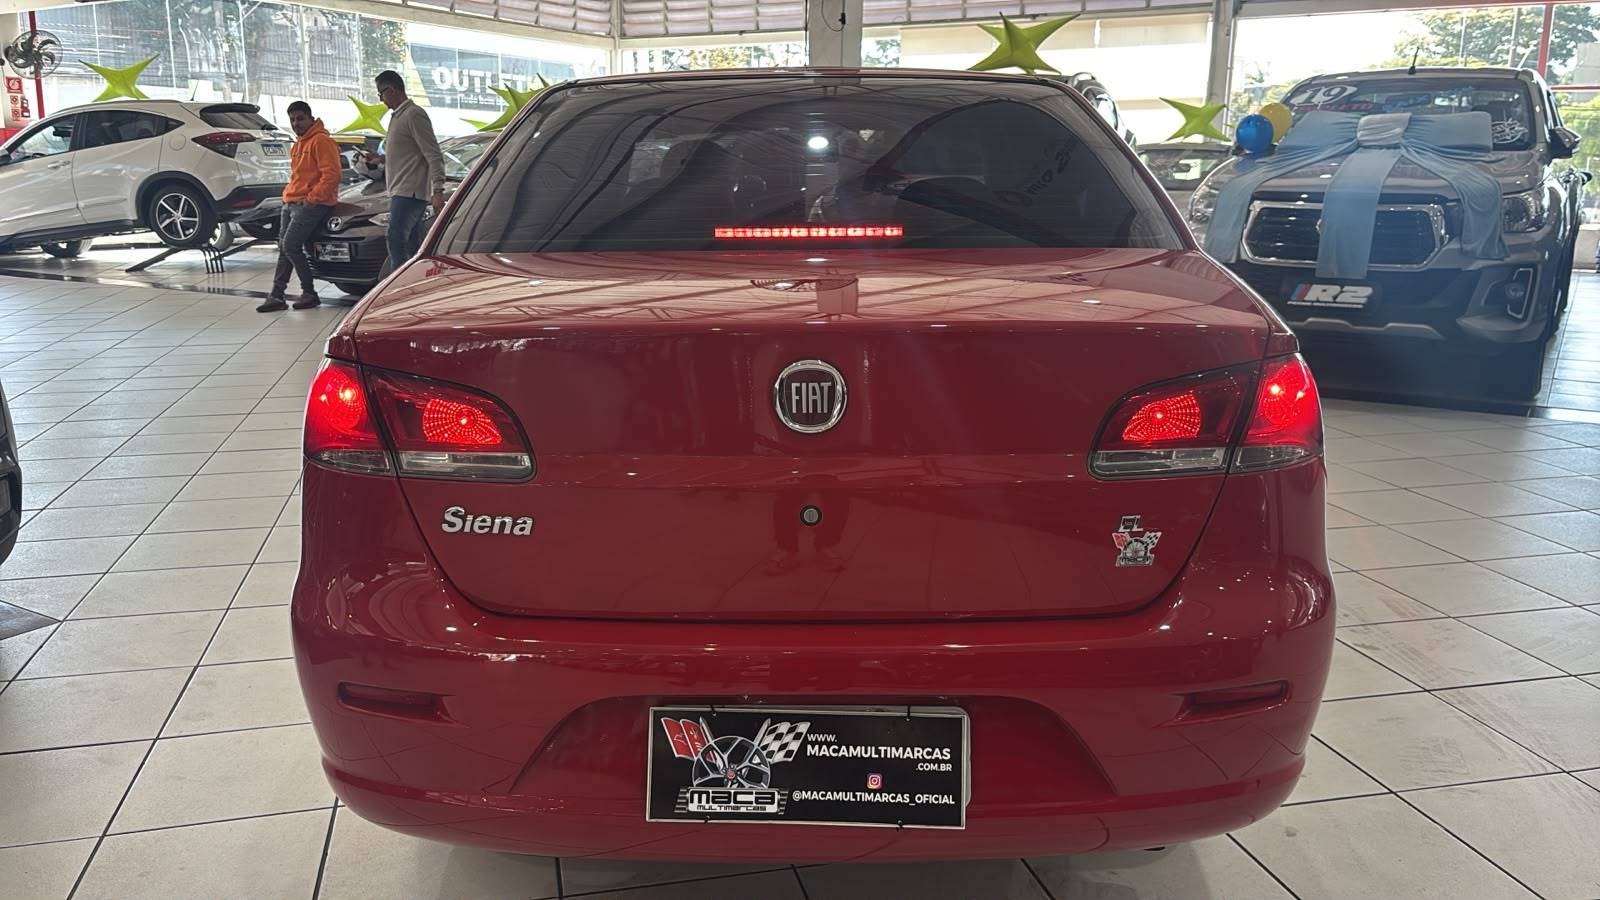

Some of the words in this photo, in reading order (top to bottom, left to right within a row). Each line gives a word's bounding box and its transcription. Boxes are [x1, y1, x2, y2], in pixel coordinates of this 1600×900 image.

[1298, 85, 1348, 104] 19
[791, 382, 832, 413] FIAT
[441, 506, 534, 535] Siena
[806, 745, 951, 760] MACAMULTIMARCAS
[915, 763, 953, 772] .COM.BR
[792, 790, 955, 806] @MACAMULTIMARCAS_OFICIAL
